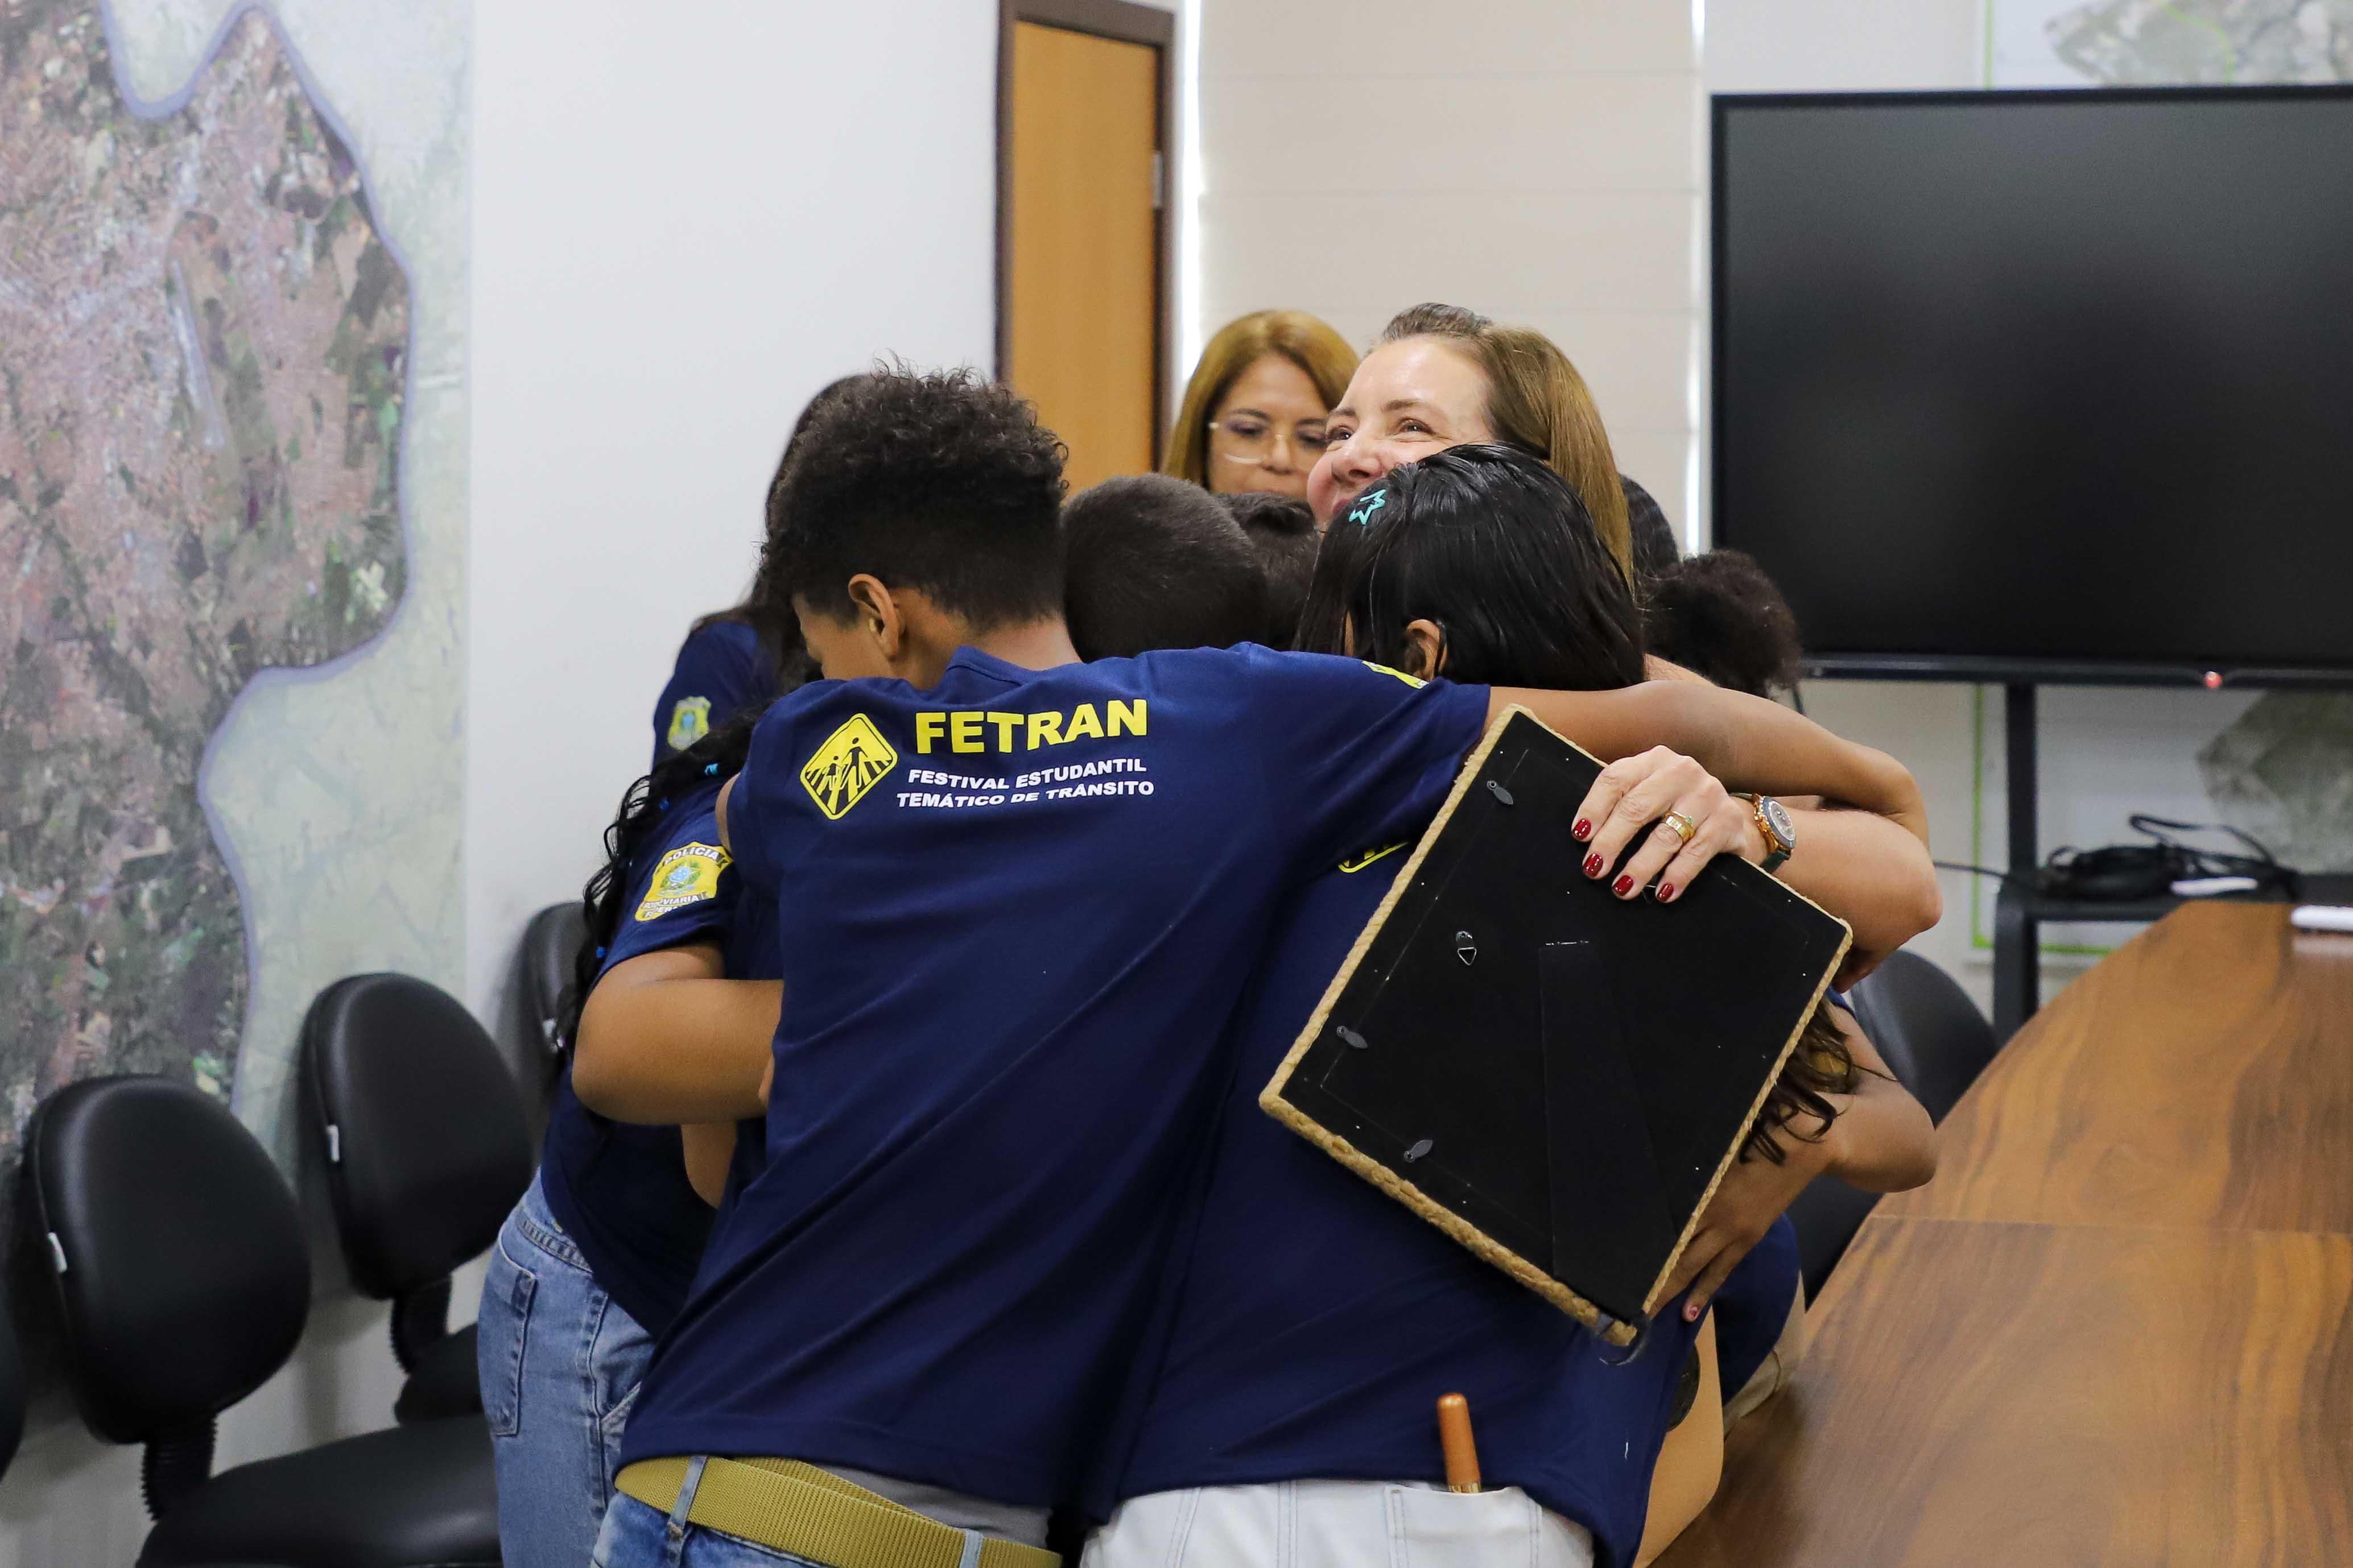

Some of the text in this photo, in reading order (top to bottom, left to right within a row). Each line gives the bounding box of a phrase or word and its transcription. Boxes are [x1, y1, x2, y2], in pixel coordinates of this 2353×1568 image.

[915, 698, 1147, 754] FETRAN
[908, 758, 1147, 789] FESTIVAL ESTUDANTIL
[897, 792, 1005, 808] TEMÁTICO
[1010, 792, 1040, 803] DE
